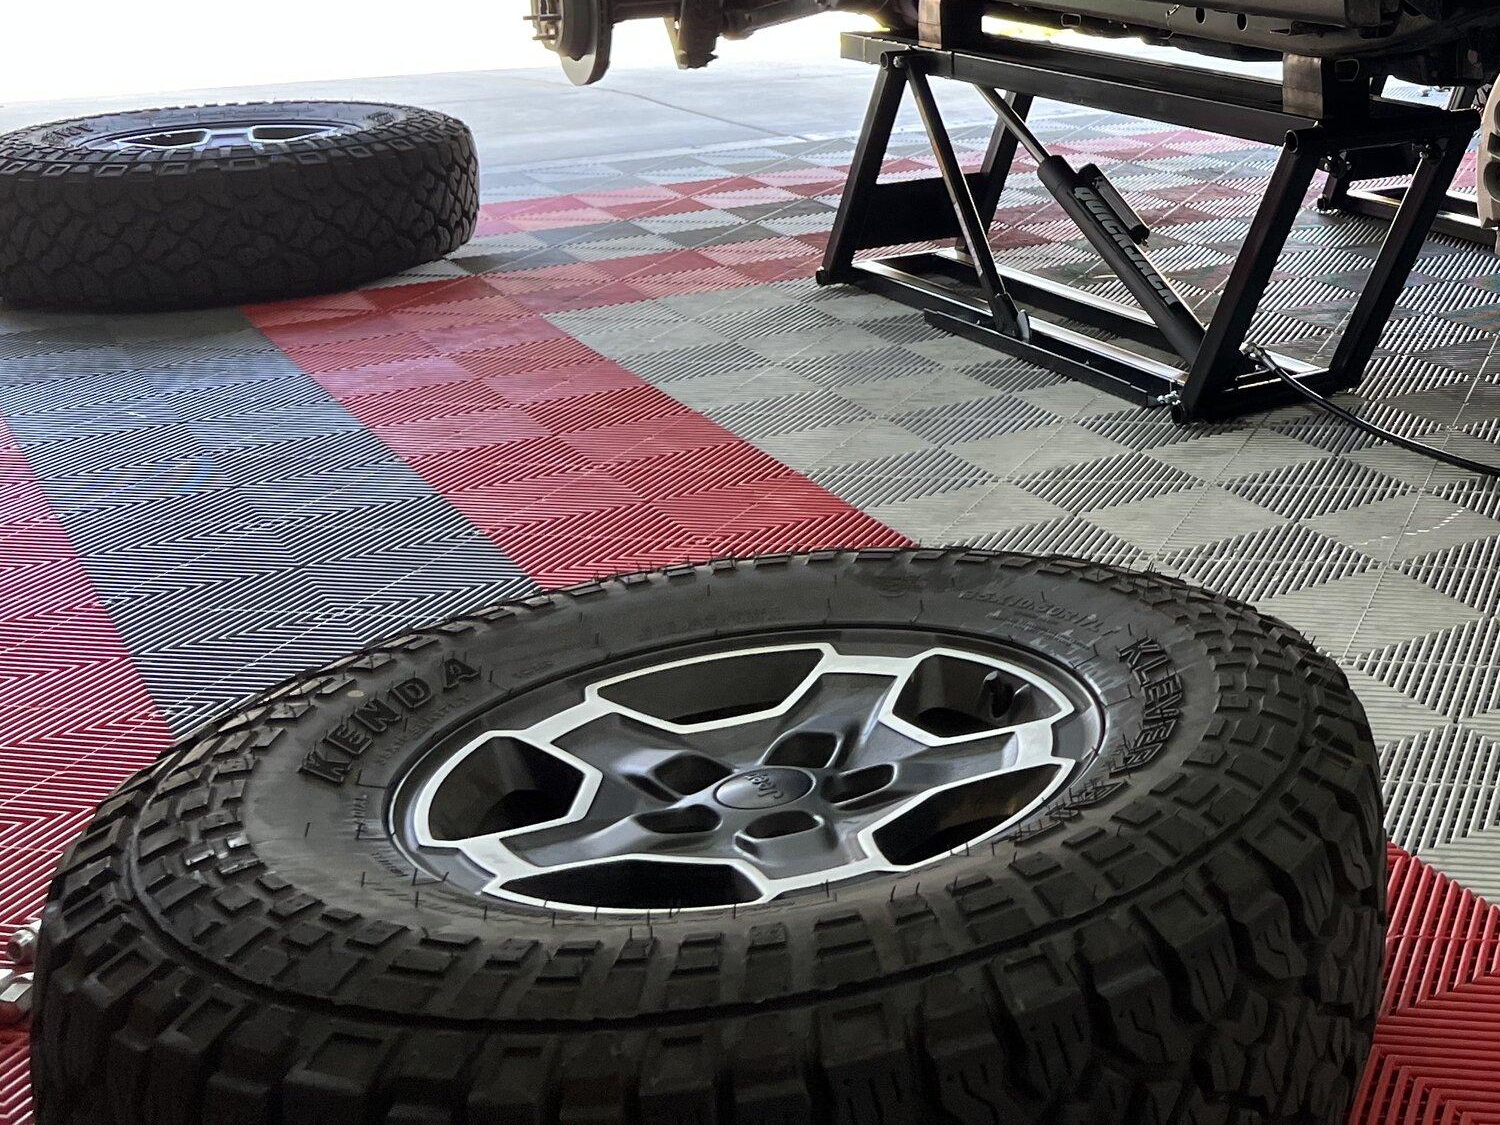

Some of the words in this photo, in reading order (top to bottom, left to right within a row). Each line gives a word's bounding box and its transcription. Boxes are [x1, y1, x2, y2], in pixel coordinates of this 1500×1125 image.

[1074, 186, 1179, 306] QUICKJACK
[298, 656, 481, 785] KENDA
[1108, 633, 1186, 779] KLEVER
